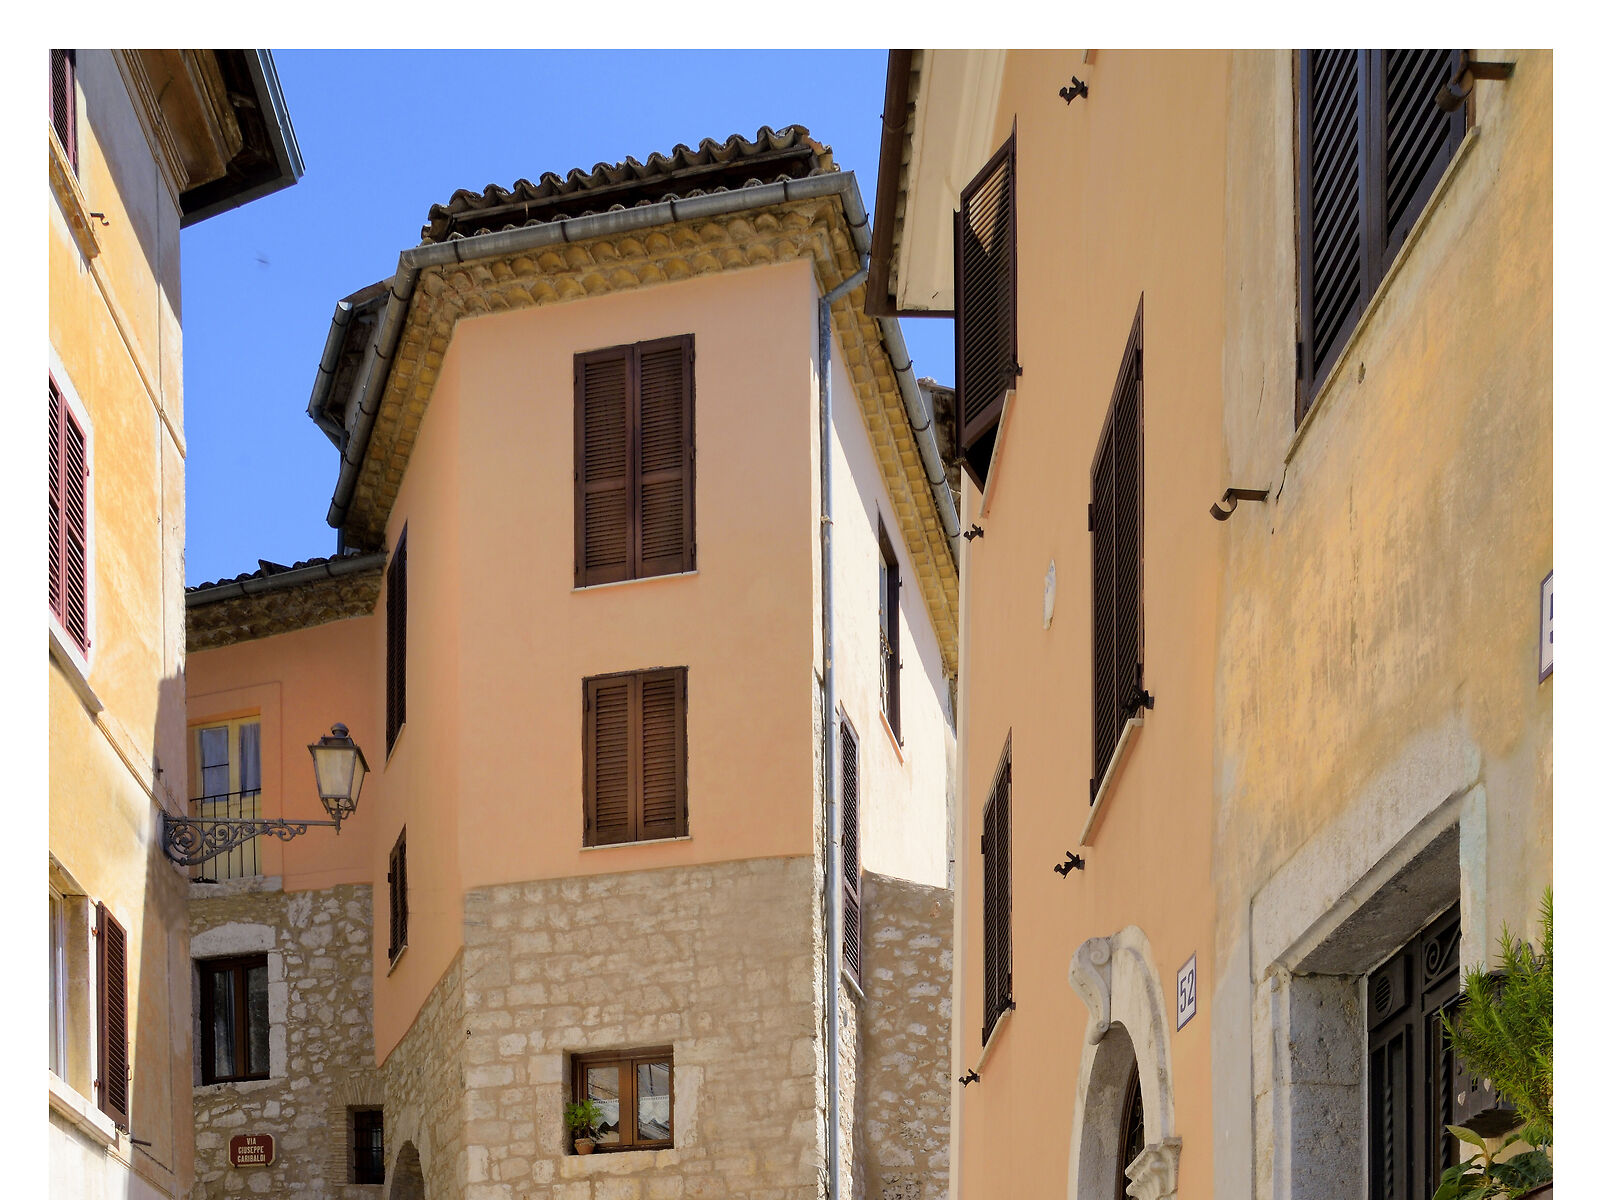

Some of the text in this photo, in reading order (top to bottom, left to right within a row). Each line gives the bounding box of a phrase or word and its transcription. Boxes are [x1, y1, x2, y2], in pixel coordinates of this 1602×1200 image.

[1180, 969, 1194, 1013] 52
[246, 1137, 257, 1145] VIA
[238, 1145, 264, 1154] GIUSEPPE
[237, 1154, 266, 1163] GARIBALDI
